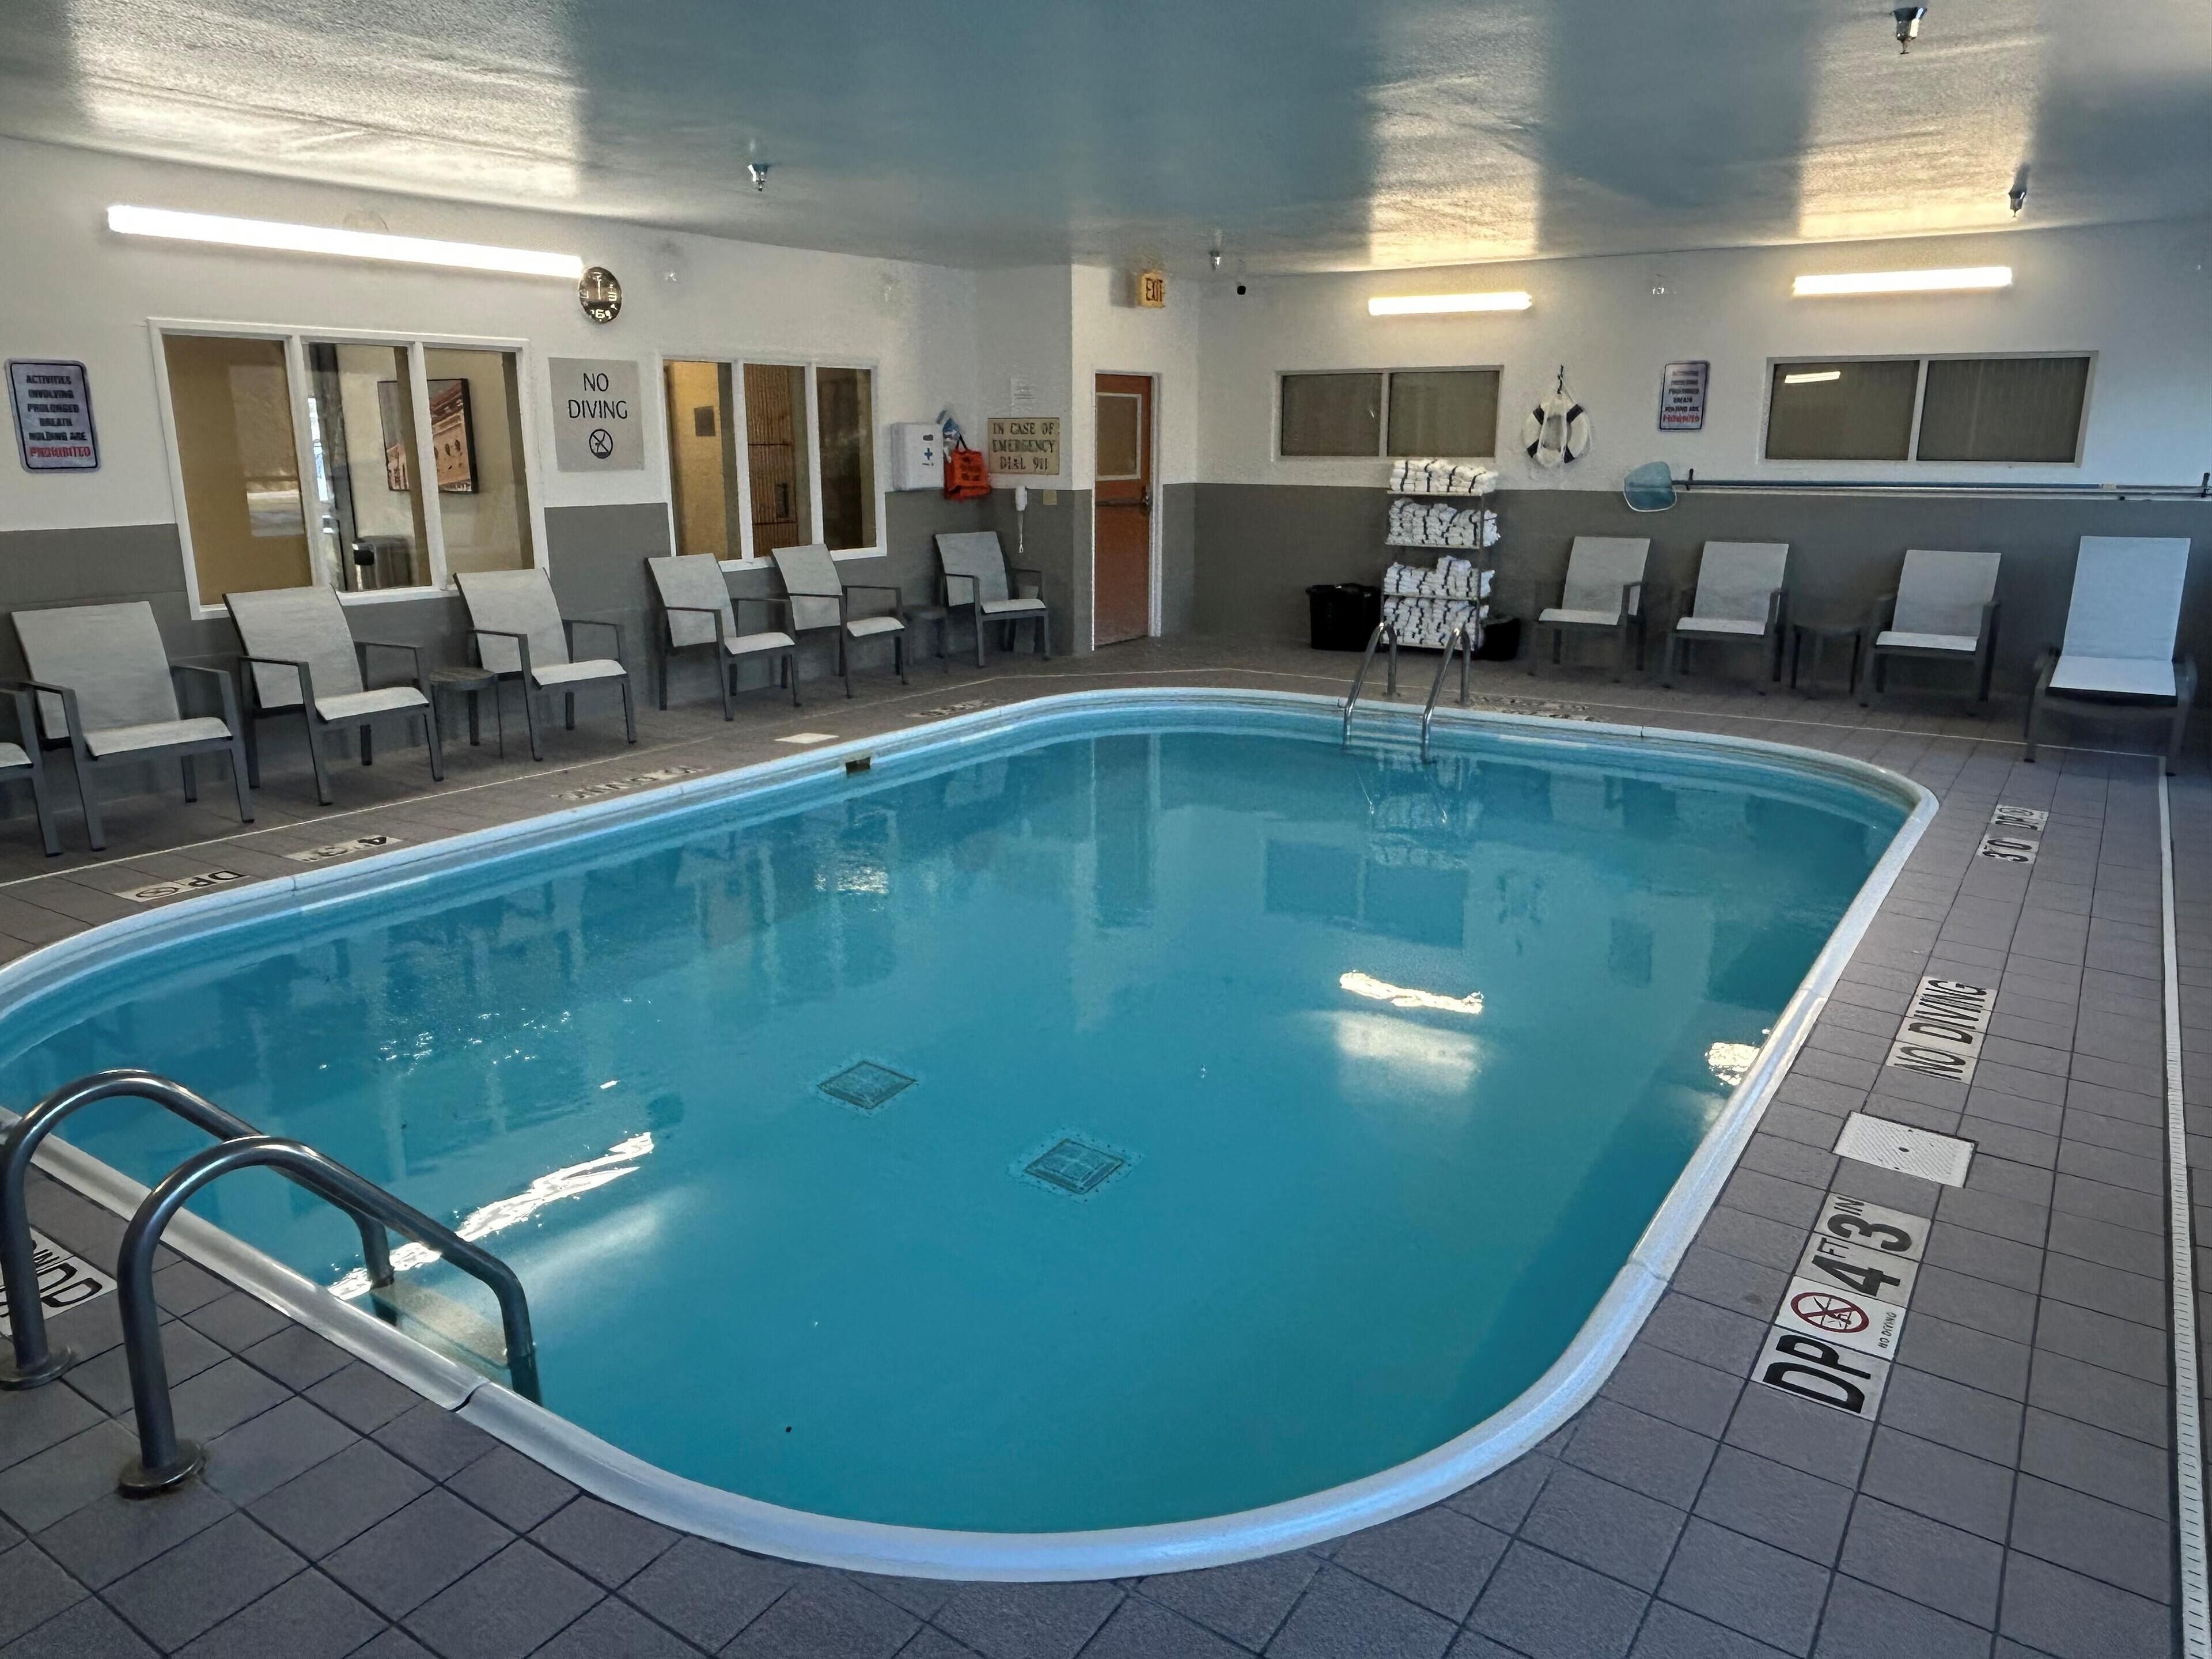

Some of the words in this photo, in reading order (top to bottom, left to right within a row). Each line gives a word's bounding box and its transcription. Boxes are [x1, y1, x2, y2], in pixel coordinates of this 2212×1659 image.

[583, 373, 609, 392] NO
[568, 400, 628, 419] DIVING
[993, 422, 1004, 434] IN
[1010, 422, 1036, 434] CASE
[1042, 422, 1054, 435] OF
[1033, 457, 1048, 470] 911
[188, 870, 247, 887] DP
[1908, 980, 1987, 1044] DIVING
[1893, 1047, 1966, 1081] NO
[1762, 1334, 1872, 1414] DP
